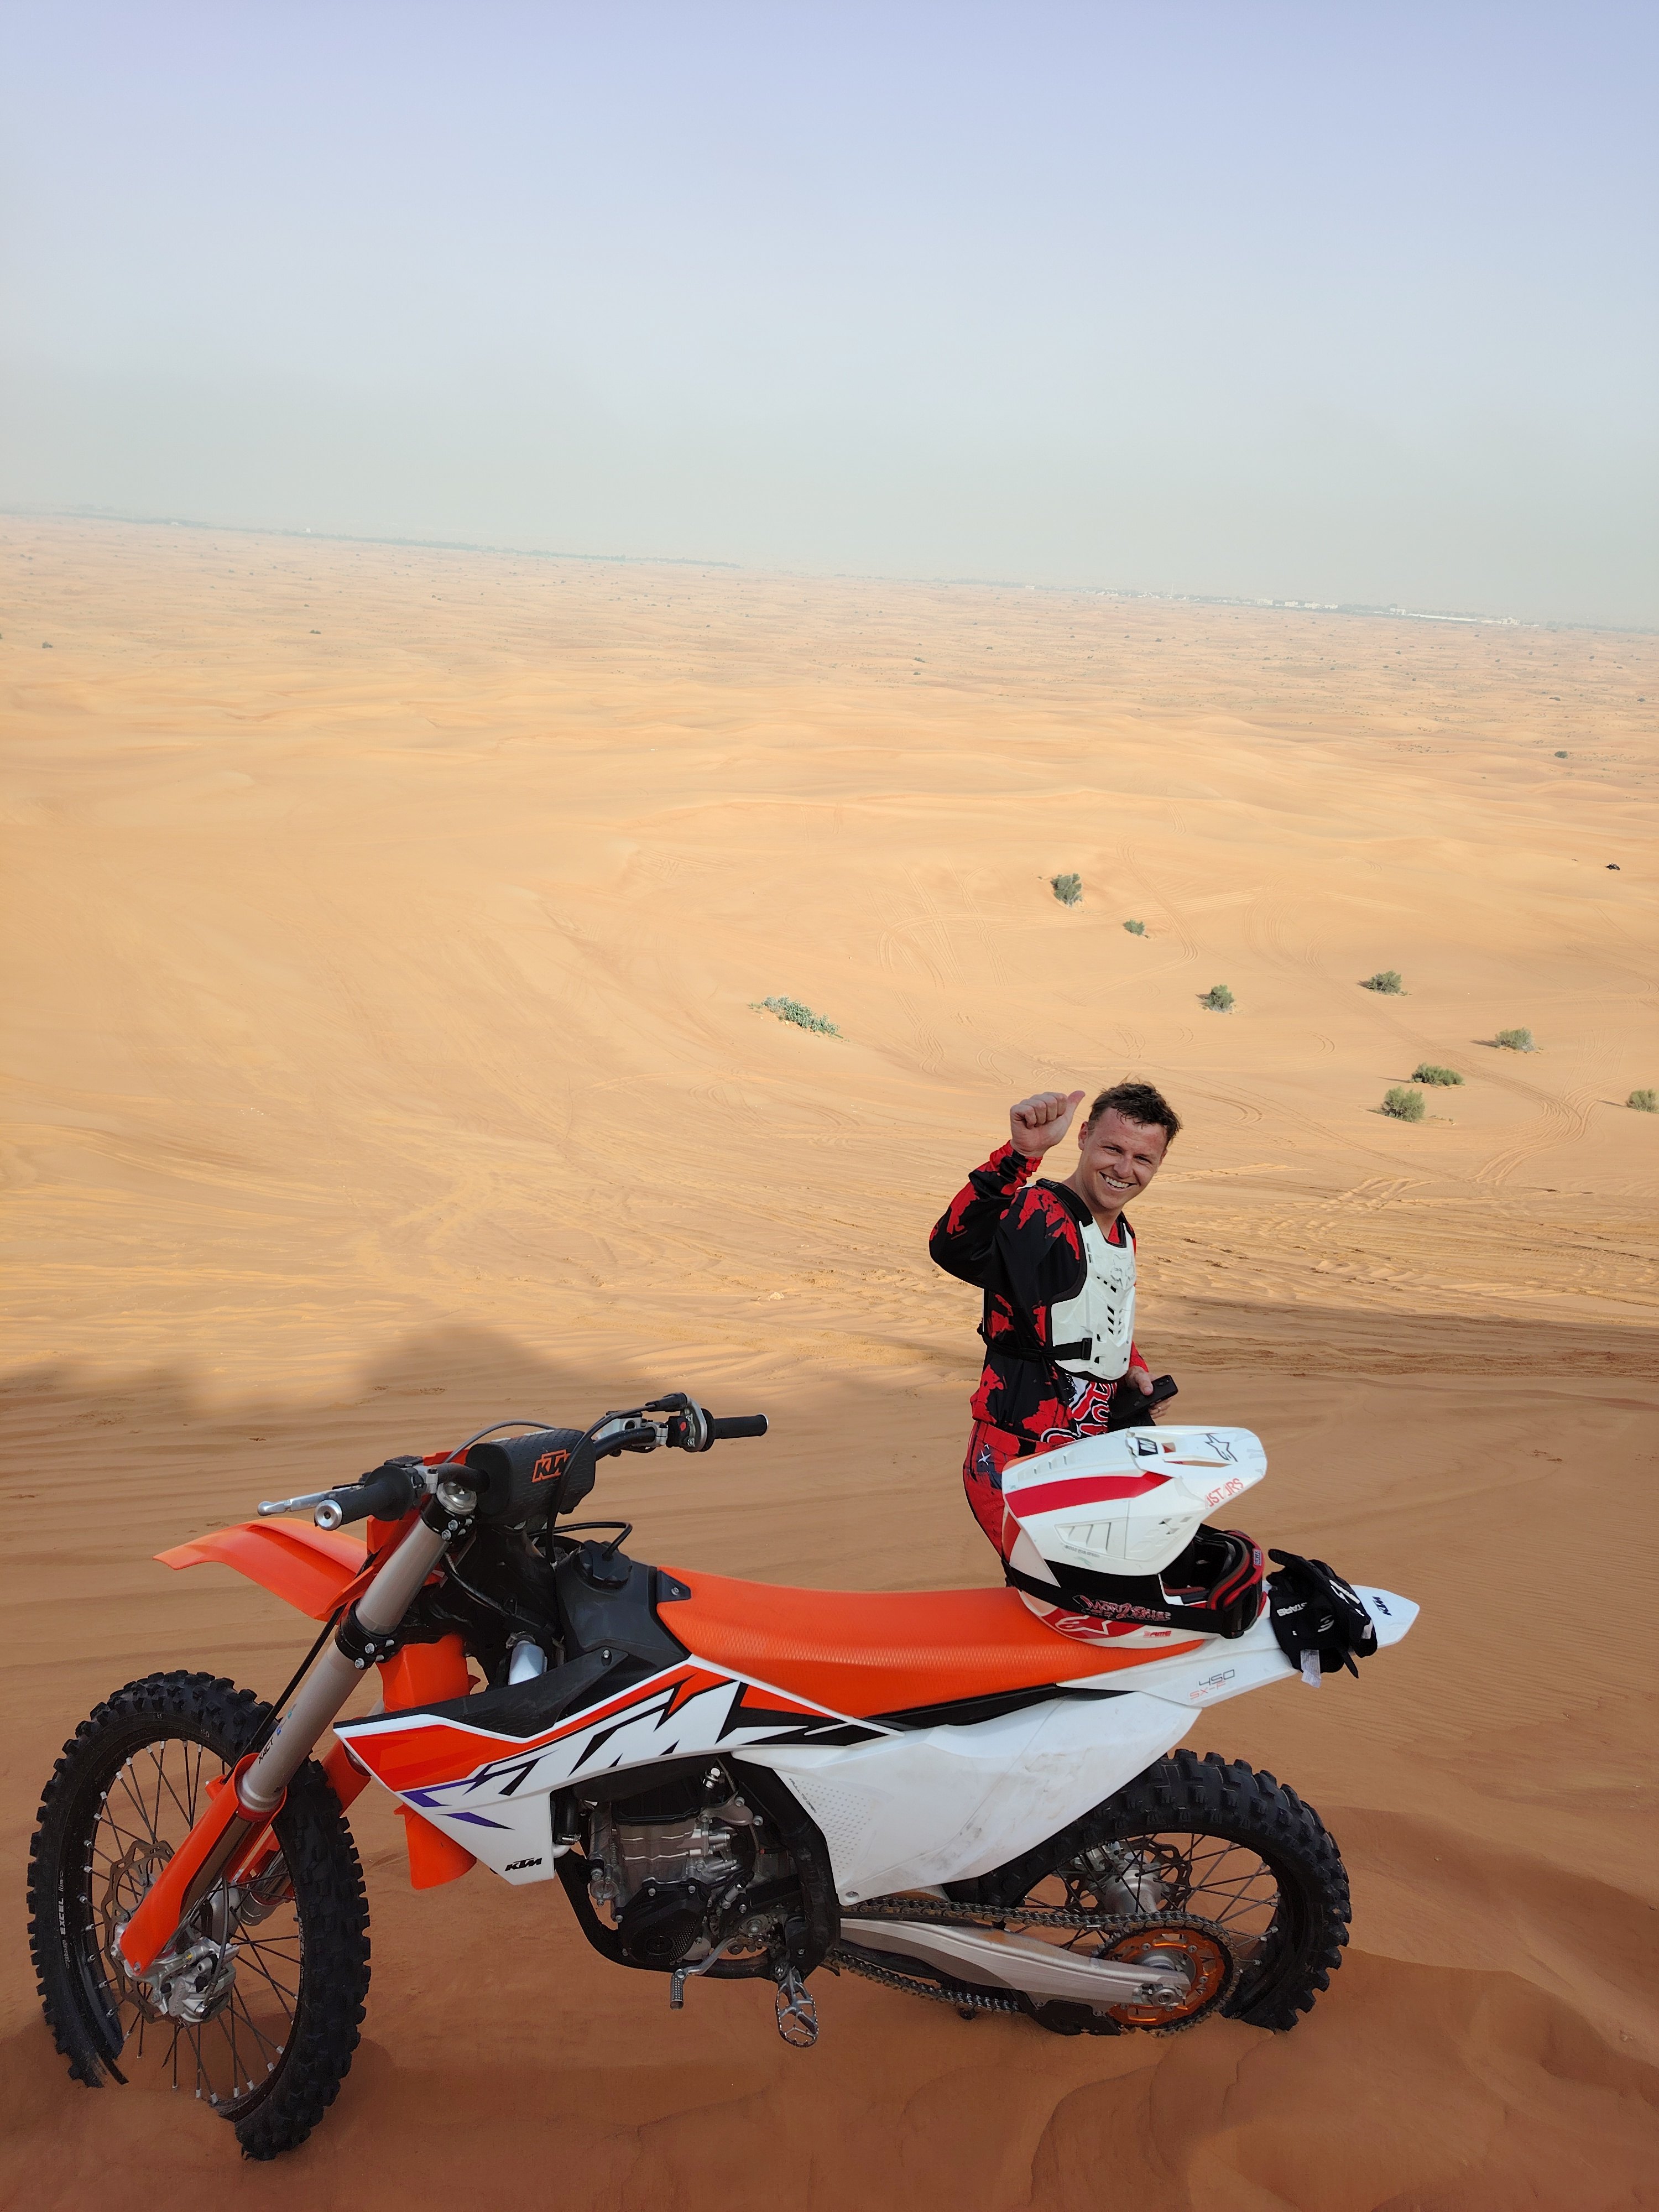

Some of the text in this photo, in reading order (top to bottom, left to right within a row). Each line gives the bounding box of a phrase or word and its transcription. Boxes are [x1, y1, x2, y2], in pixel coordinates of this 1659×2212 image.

[1371, 1596, 1392, 1616] KTM
[1198, 1669, 1235, 1686] 450
[1190, 1680, 1226, 1700] SX-F
[258, 1736, 274, 1765] XACT
[504, 1857, 543, 1871] KTM
